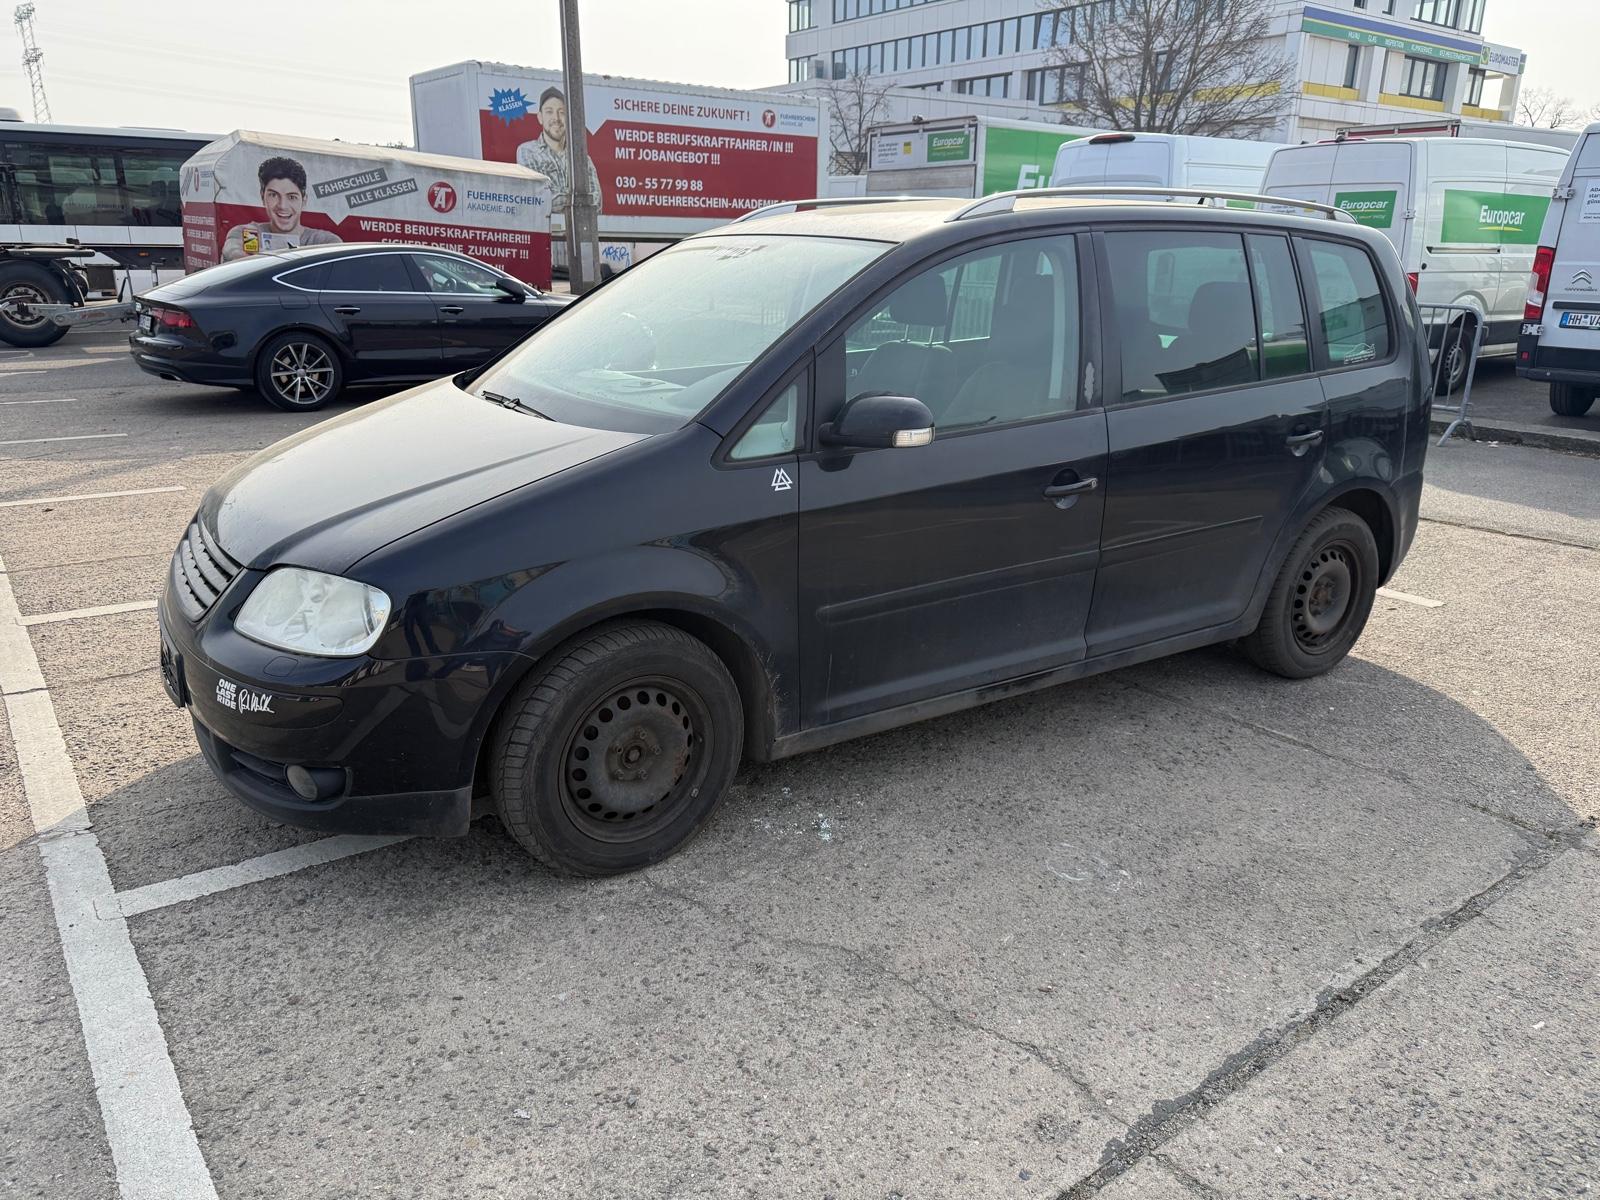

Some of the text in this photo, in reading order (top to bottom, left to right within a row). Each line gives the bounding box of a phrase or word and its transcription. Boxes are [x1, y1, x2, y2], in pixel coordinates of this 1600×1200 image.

[1489, 51, 1519, 67] EUROMASTER
[498, 101, 522, 112] KLASSEN
[502, 95, 515, 104] ALLE
[614, 98, 660, 114] SICHERE
[662, 103, 694, 117] DEINE
[697, 106, 745, 121] ZUKUNFT
[614, 128, 655, 143] WERDE
[932, 137, 965, 148] Europcar
[615, 147, 636, 160] MIT
[638, 149, 710, 164] JOBANGEBOT
[318, 171, 381, 195] FAHRSCHULE
[616, 176, 637, 188] 030
[645, 178, 658, 189] 55
[660, 178, 673, 190] 77
[675, 179, 688, 191] 99
[690, 180, 703, 191] 88
[350, 180, 416, 206] ALLE KLASSEN
[467, 190, 545, 206] FUEHRERSCHEIN-
[616, 193, 786, 210] WWW.FUEHRERSCHEIN-AKADEMI
[1340, 200, 1388, 211] Europcar
[1479, 204, 1525, 230] Europcar
[360, 220, 401, 233] WERDE
[468, 245, 517, 259] ZUKUNFT
[216, 685, 236, 701] LAST
[219, 679, 237, 693] ONE
[216, 694, 236, 710] RIDE
